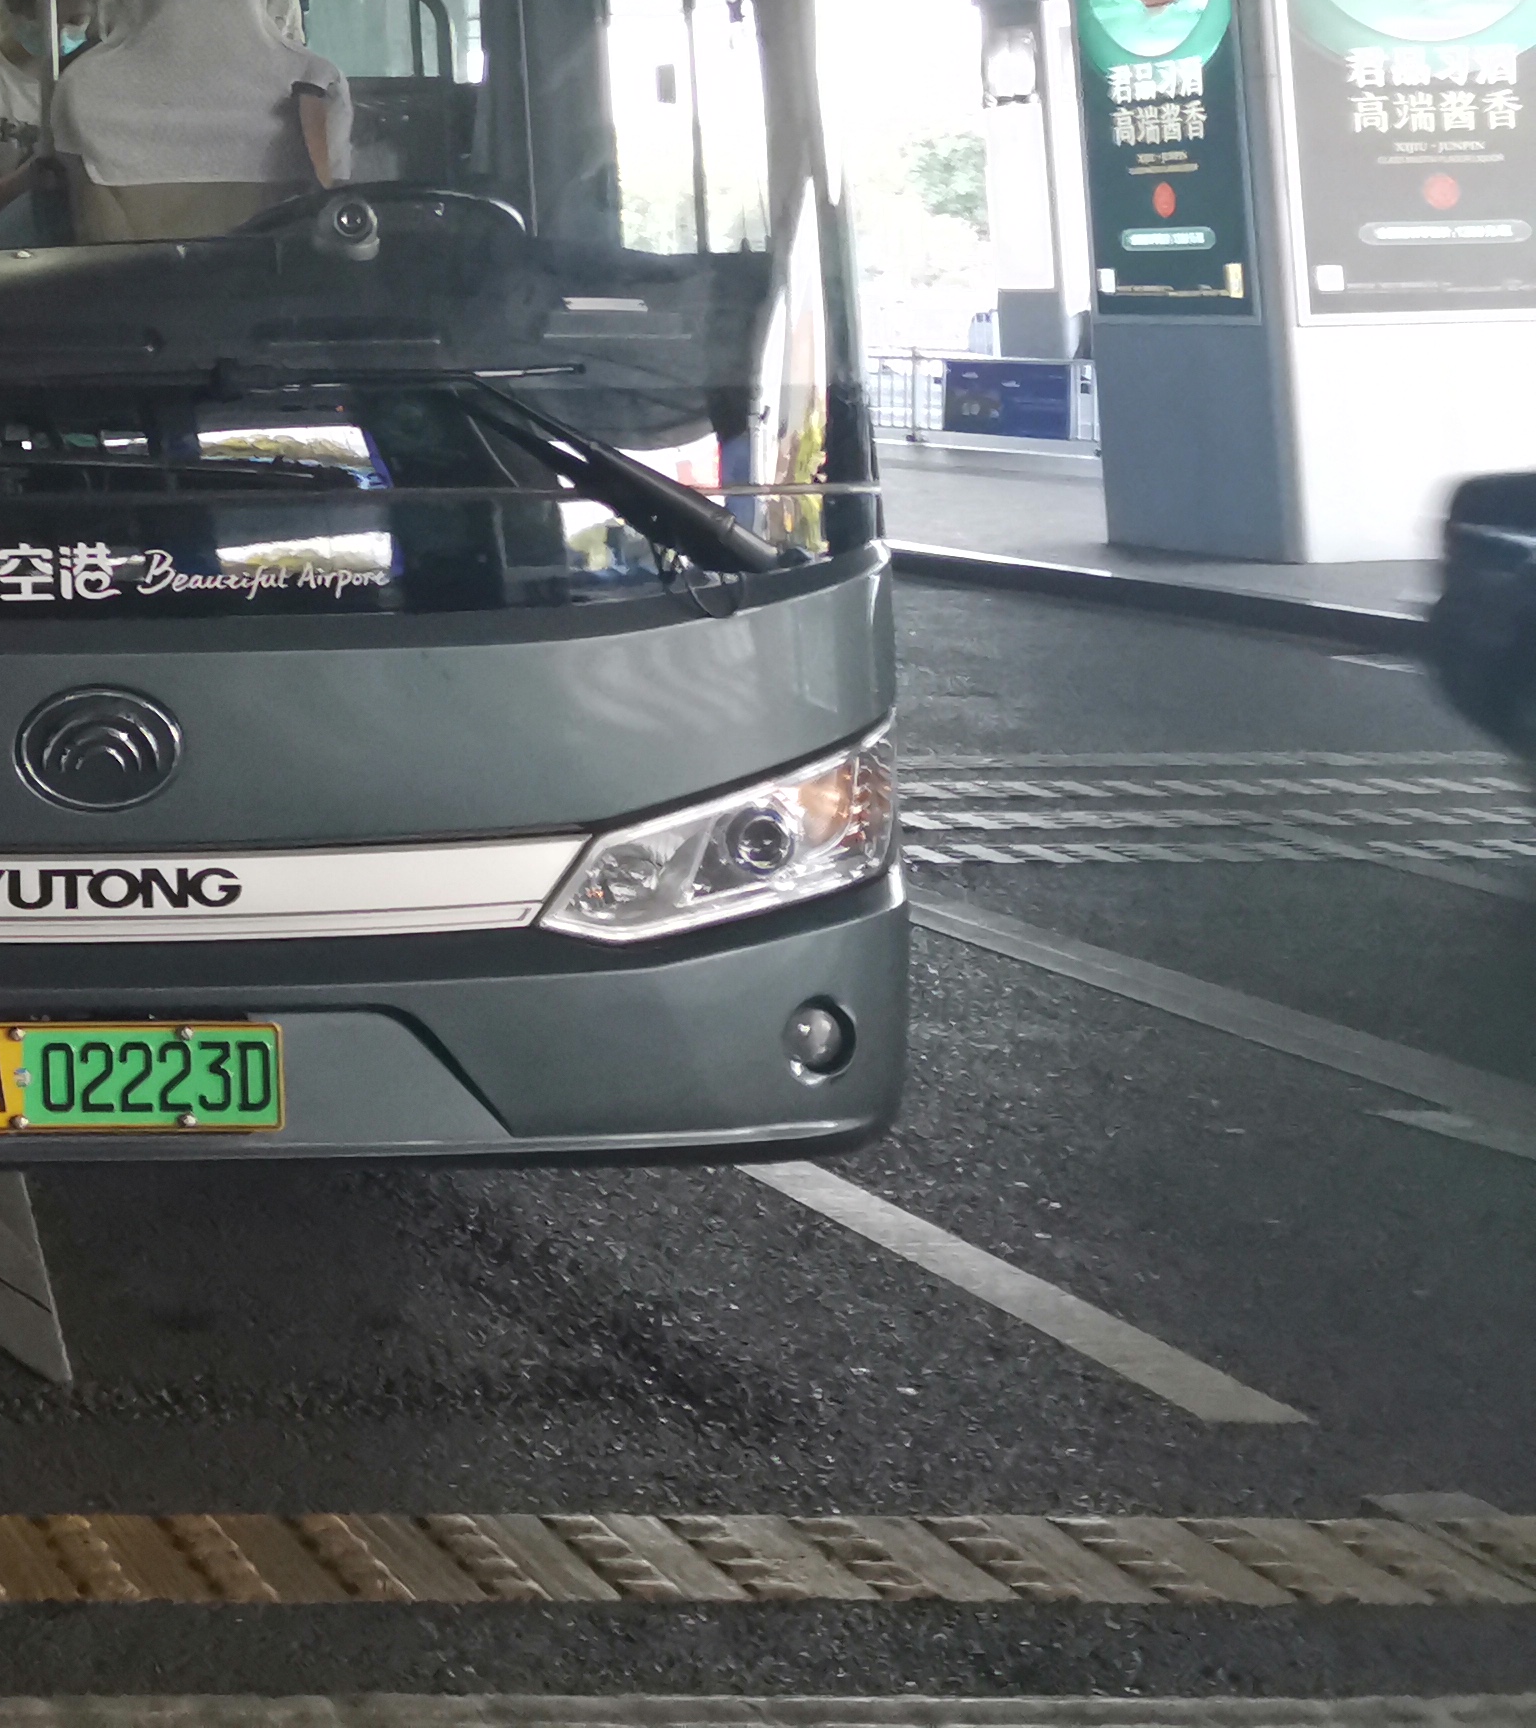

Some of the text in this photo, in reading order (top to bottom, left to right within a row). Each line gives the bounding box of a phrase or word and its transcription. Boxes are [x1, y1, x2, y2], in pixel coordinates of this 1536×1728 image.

[1111, 100, 1208, 147] 高端酱香
[1349, 88, 1523, 134] 高端酱香
